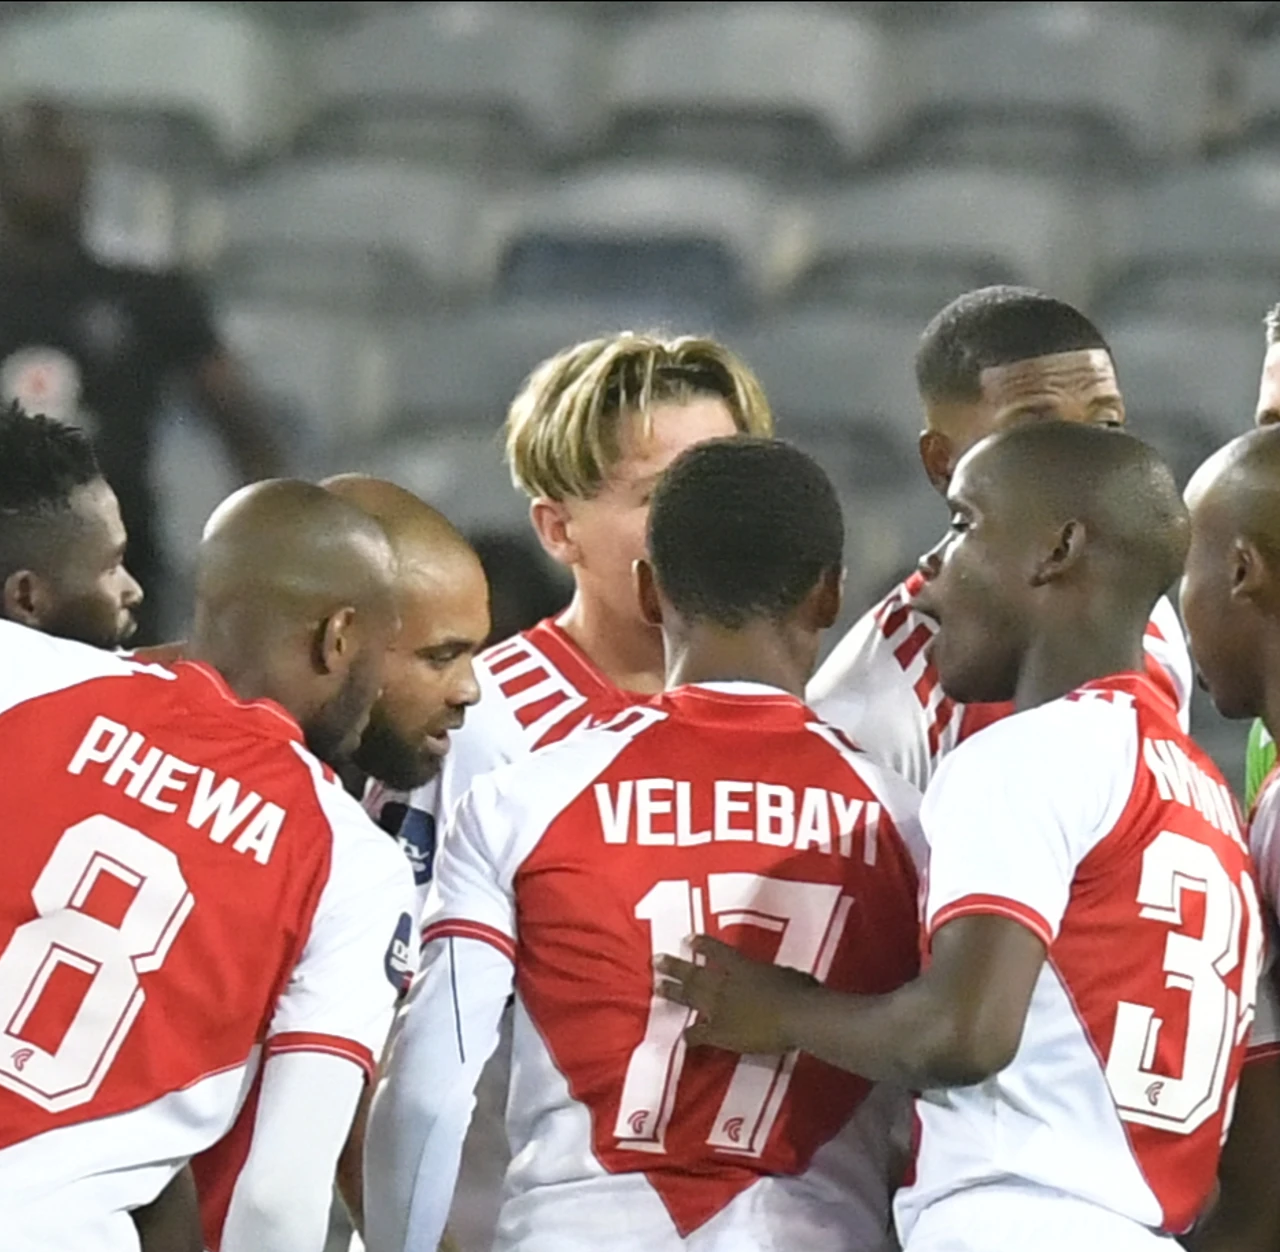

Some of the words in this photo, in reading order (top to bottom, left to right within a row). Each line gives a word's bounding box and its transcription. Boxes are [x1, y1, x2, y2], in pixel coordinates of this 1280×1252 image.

[67, 715, 286, 865] PHEWA
[594, 777, 880, 866] VELEBAYI
[614, 872, 853, 1158] 17
